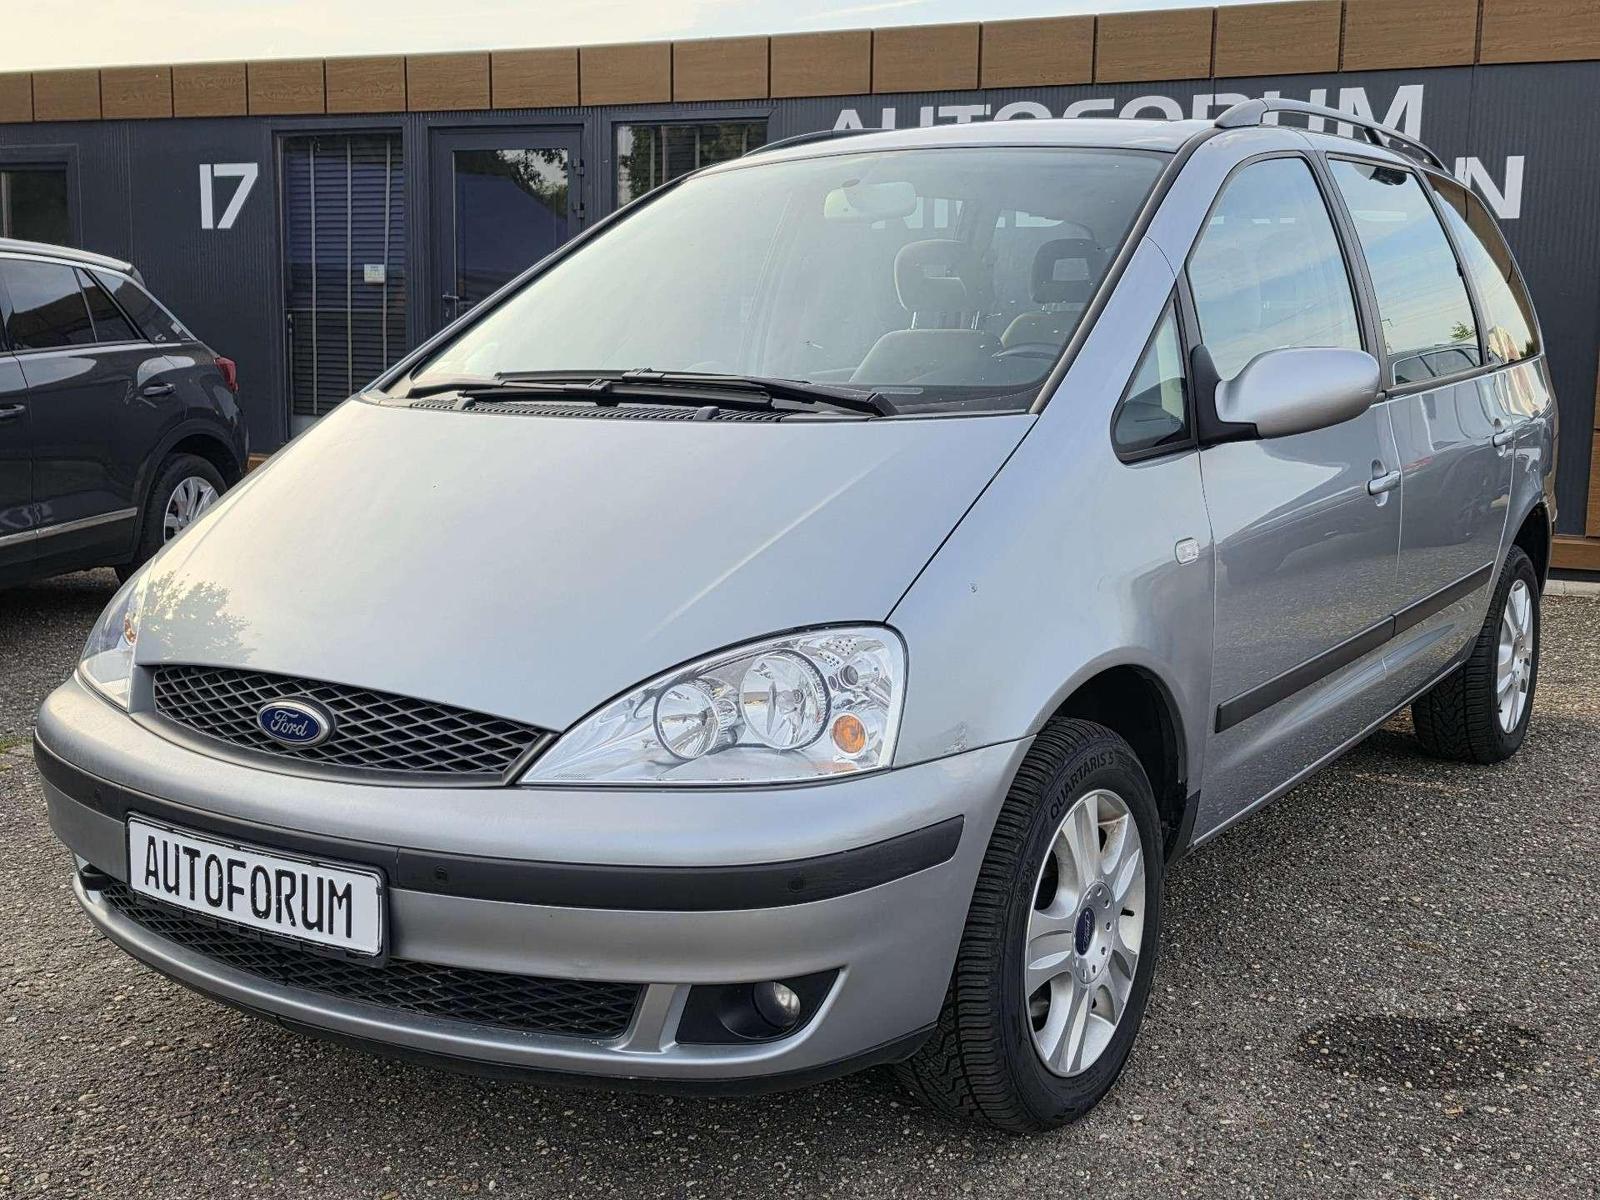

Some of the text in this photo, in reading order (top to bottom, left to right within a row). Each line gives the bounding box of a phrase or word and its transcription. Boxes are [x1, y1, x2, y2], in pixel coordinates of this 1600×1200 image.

[199, 163, 258, 229] 17
[270, 709, 309, 737] Ford
[1050, 753, 1107, 820] QUARTARIS
[144, 835, 352, 938] AUTOFORUM
